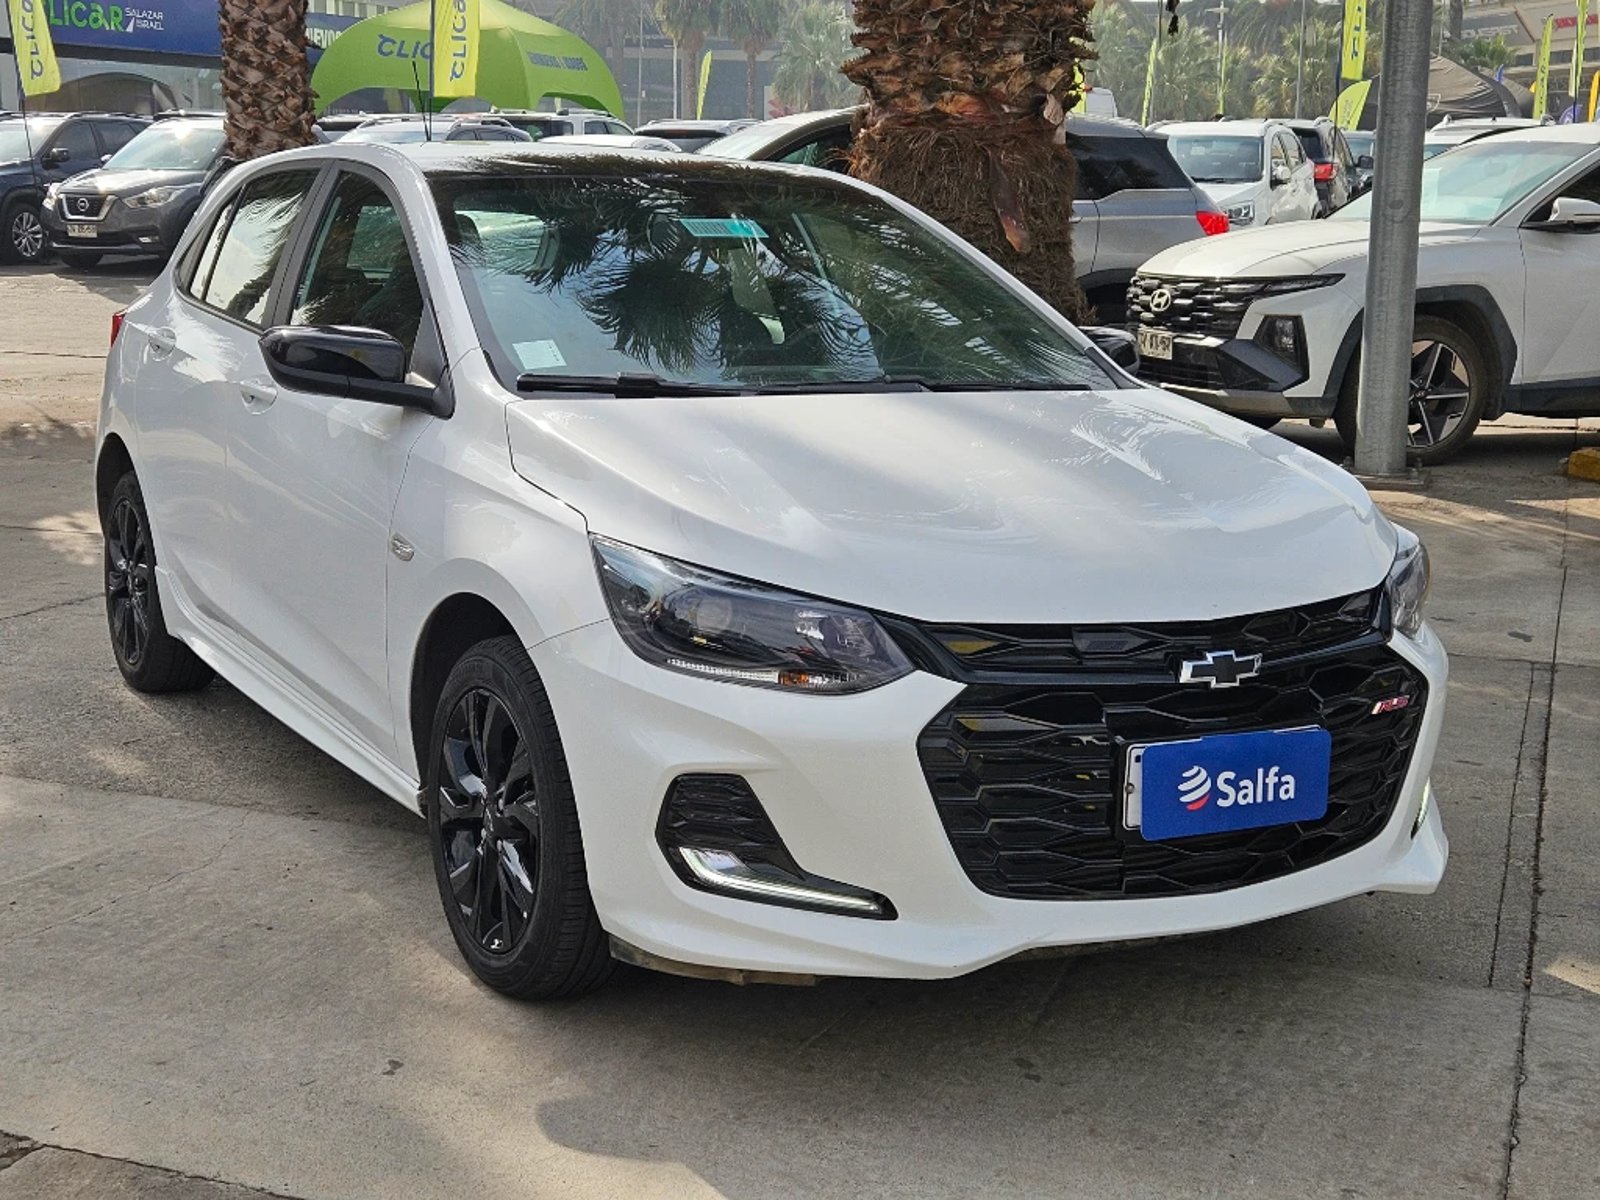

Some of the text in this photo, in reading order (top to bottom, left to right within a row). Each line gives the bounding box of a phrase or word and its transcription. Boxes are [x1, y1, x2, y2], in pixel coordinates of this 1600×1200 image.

[124, 7, 164, 20] SALAZAR
[136, 18, 164, 31] ISRAEL
[1216, 765, 1295, 808] Salfa
